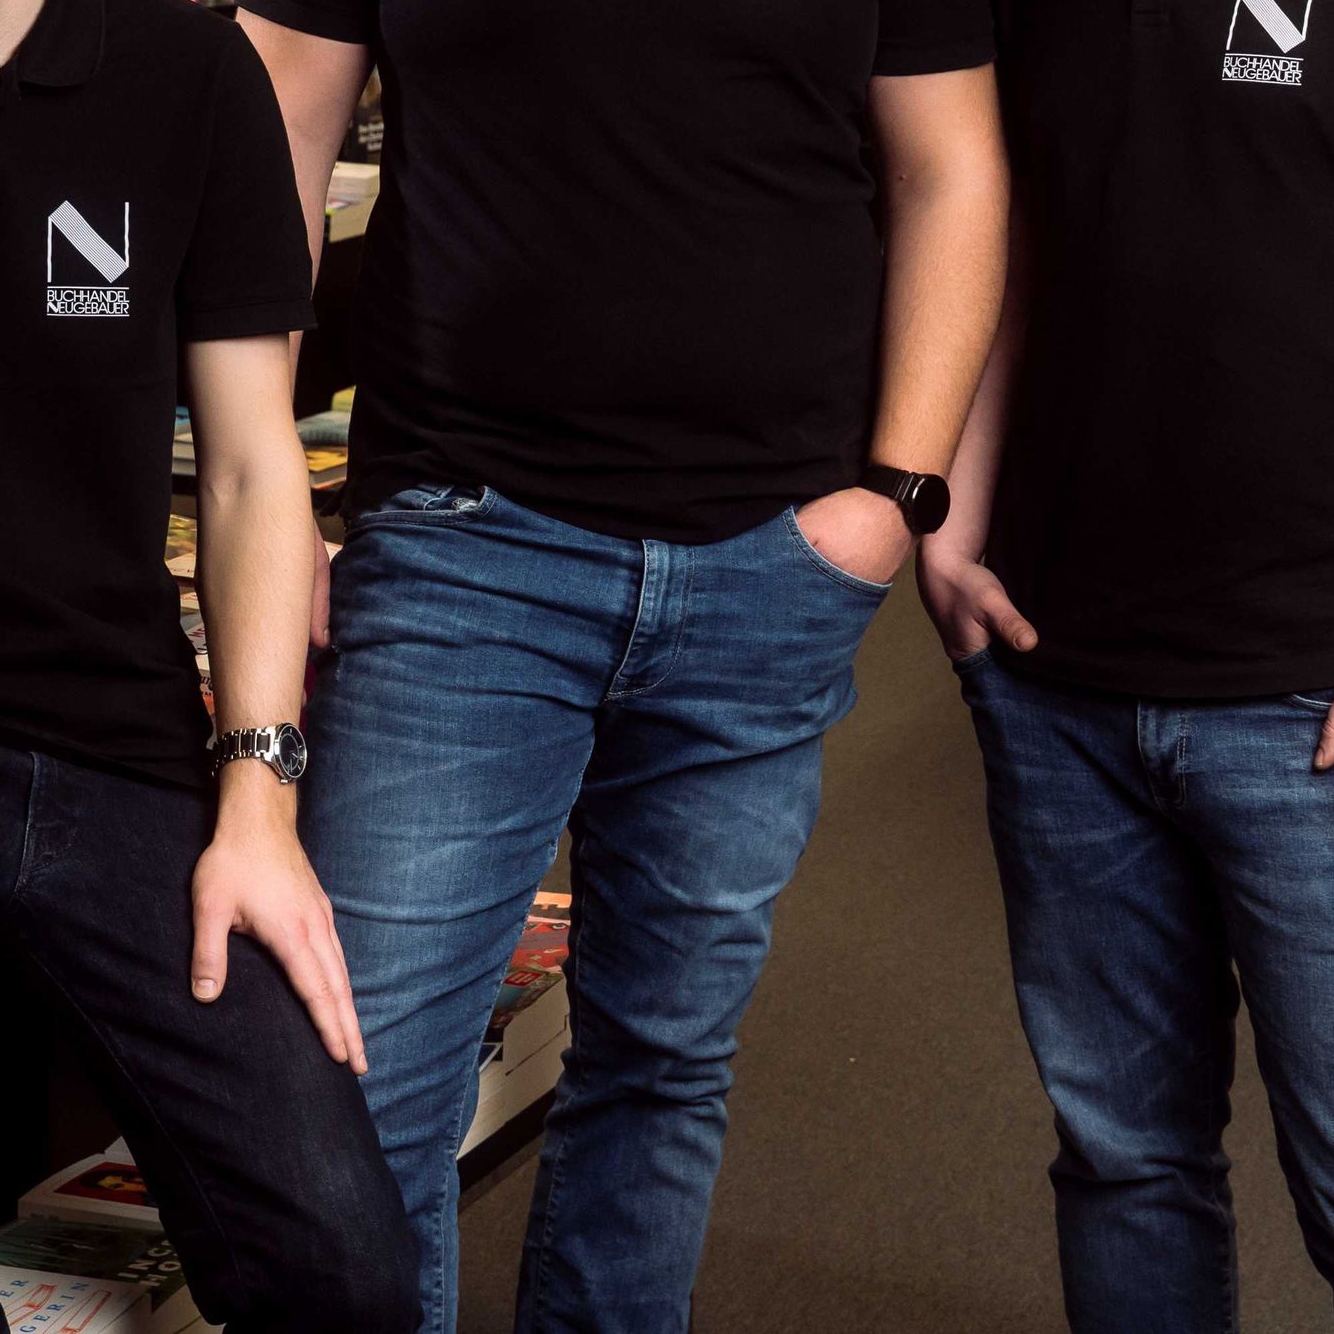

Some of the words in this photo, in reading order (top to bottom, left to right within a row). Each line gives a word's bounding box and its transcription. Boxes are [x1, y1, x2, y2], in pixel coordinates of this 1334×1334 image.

[1223, 56, 1303, 73] BUCHHANDEL
[1222, 67, 1302, 83] NEUGEBAUER
[47, 289, 130, 303] BUCHHANDEL
[47, 302, 129, 314] NEUGEBAUER
